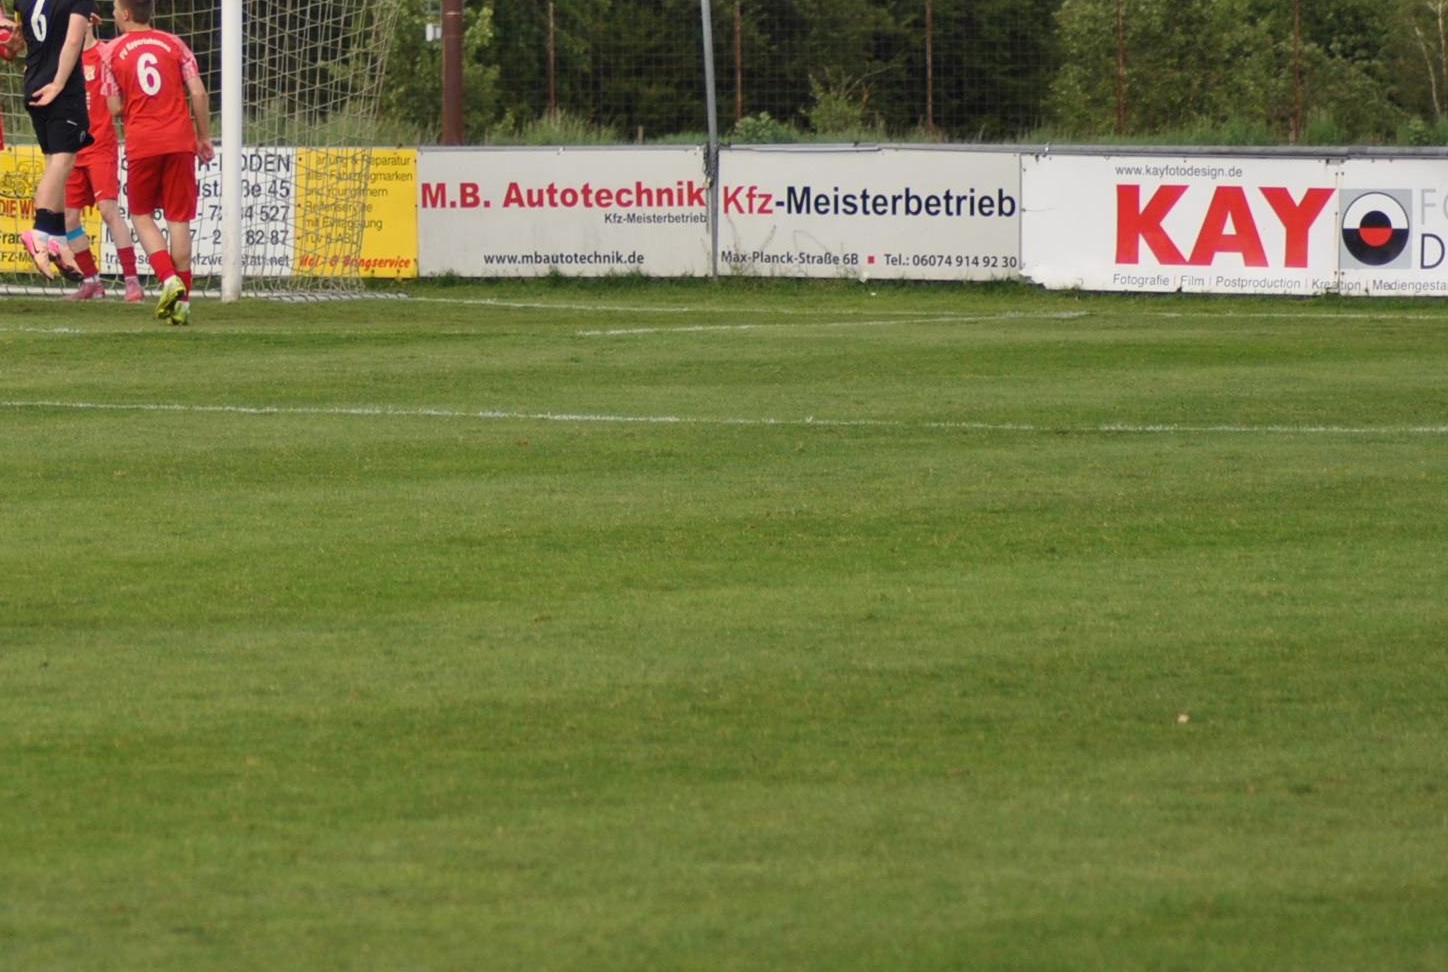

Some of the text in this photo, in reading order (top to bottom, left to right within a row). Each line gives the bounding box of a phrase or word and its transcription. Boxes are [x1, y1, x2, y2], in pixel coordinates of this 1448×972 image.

[137, 52, 162, 96] 6
[1115, 165, 1244, 179] www.kayfotodesign.de
[267, 179, 291, 198] 45
[421, 180, 708, 209] M.B. Autotechnik
[723, 185, 1017, 217] Kfz-Meisterbetrieb
[1420, 188, 1448, 226] F
[259, 204, 291, 222] 527
[604, 212, 708, 225] Kfz-Meisterbetrieb
[1115, 184, 1337, 269] KAY
[270, 229, 290, 246] 87
[483, 250, 645, 265] www.mbautotechnik.de
[721, 250, 1018, 269] Max-Planck-Straße 6B Tel.: 06074 914 92 30
[1112, 273, 1448, 294] Fotografie Film Postproduction Kreation Mediengesta
